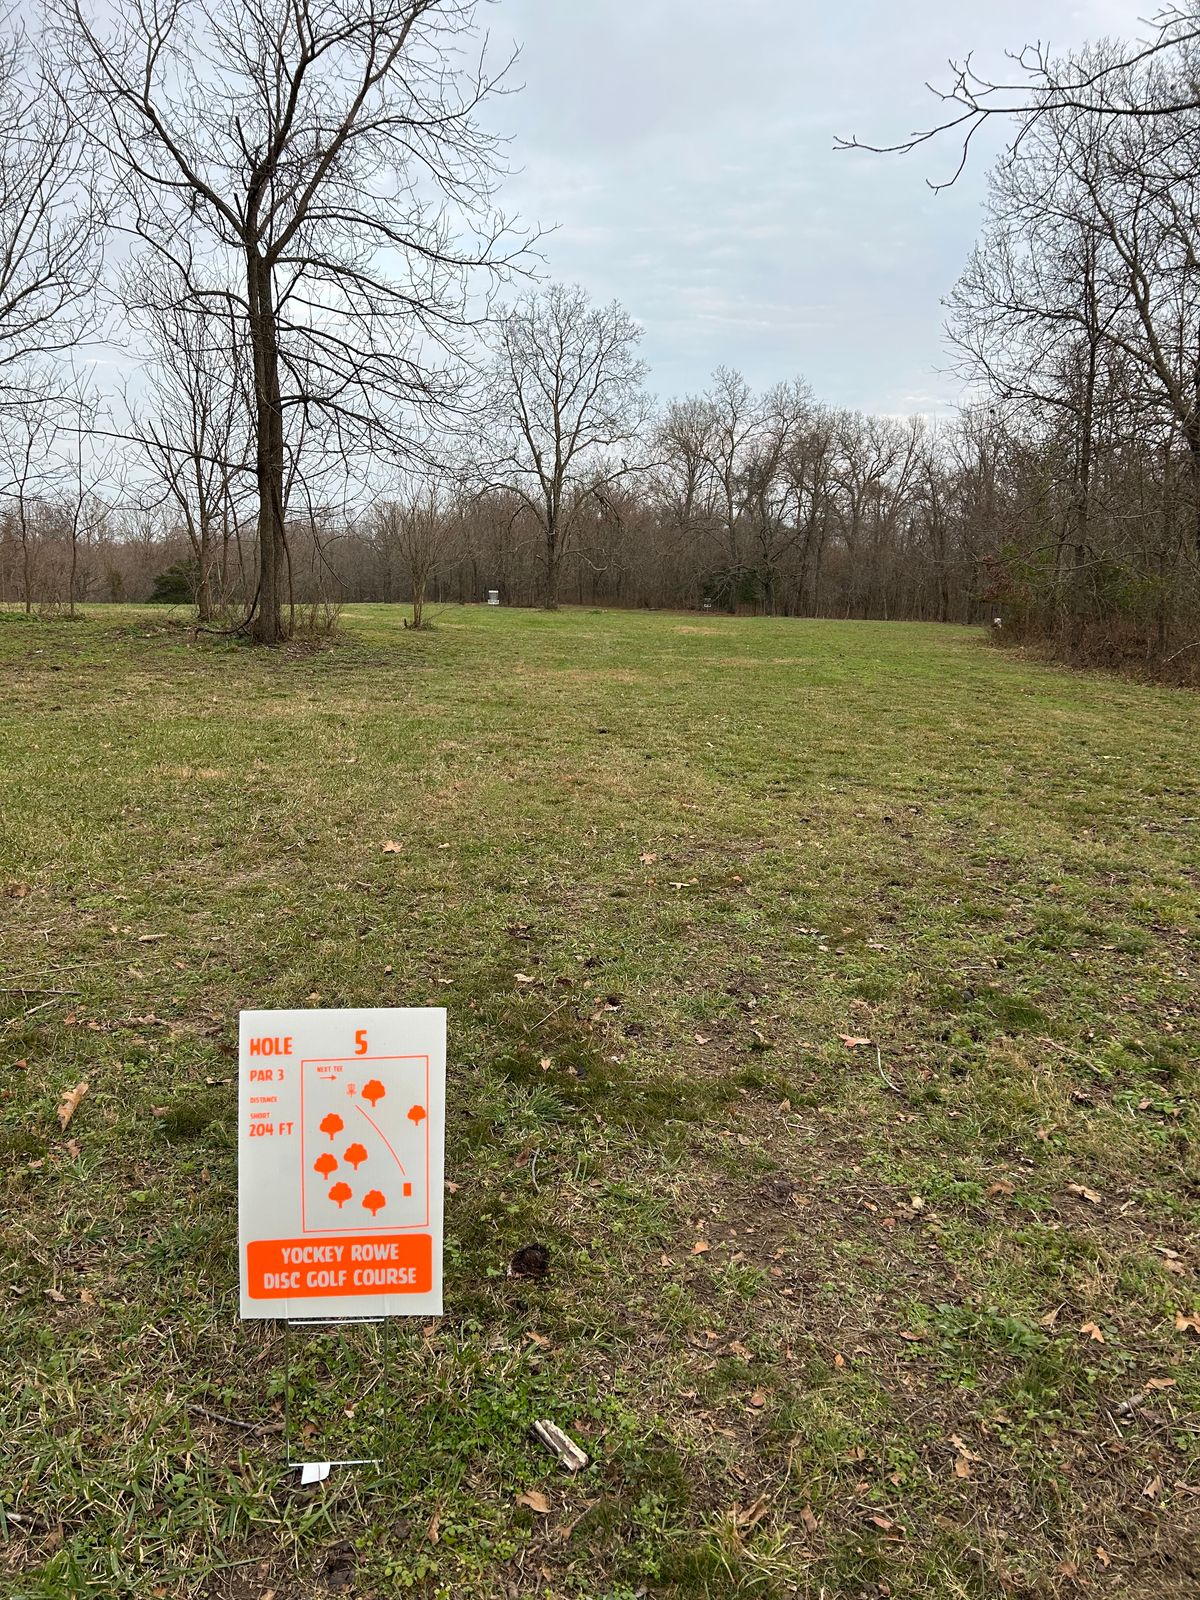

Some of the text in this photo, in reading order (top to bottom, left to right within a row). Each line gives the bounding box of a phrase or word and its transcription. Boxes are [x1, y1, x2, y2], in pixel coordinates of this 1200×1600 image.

[249, 1030, 368, 1056] HOLE 5
[249, 1069, 285, 1083] PAR 3
[316, 1065, 331, 1073] NEXT
[249, 1096, 278, 1104] DISTANCE
[249, 1122, 294, 1137] 204 FT
[282, 1244, 398, 1264] YOCKEY ROWE
[264, 1268, 416, 1289] DISC GOLF COURSE
